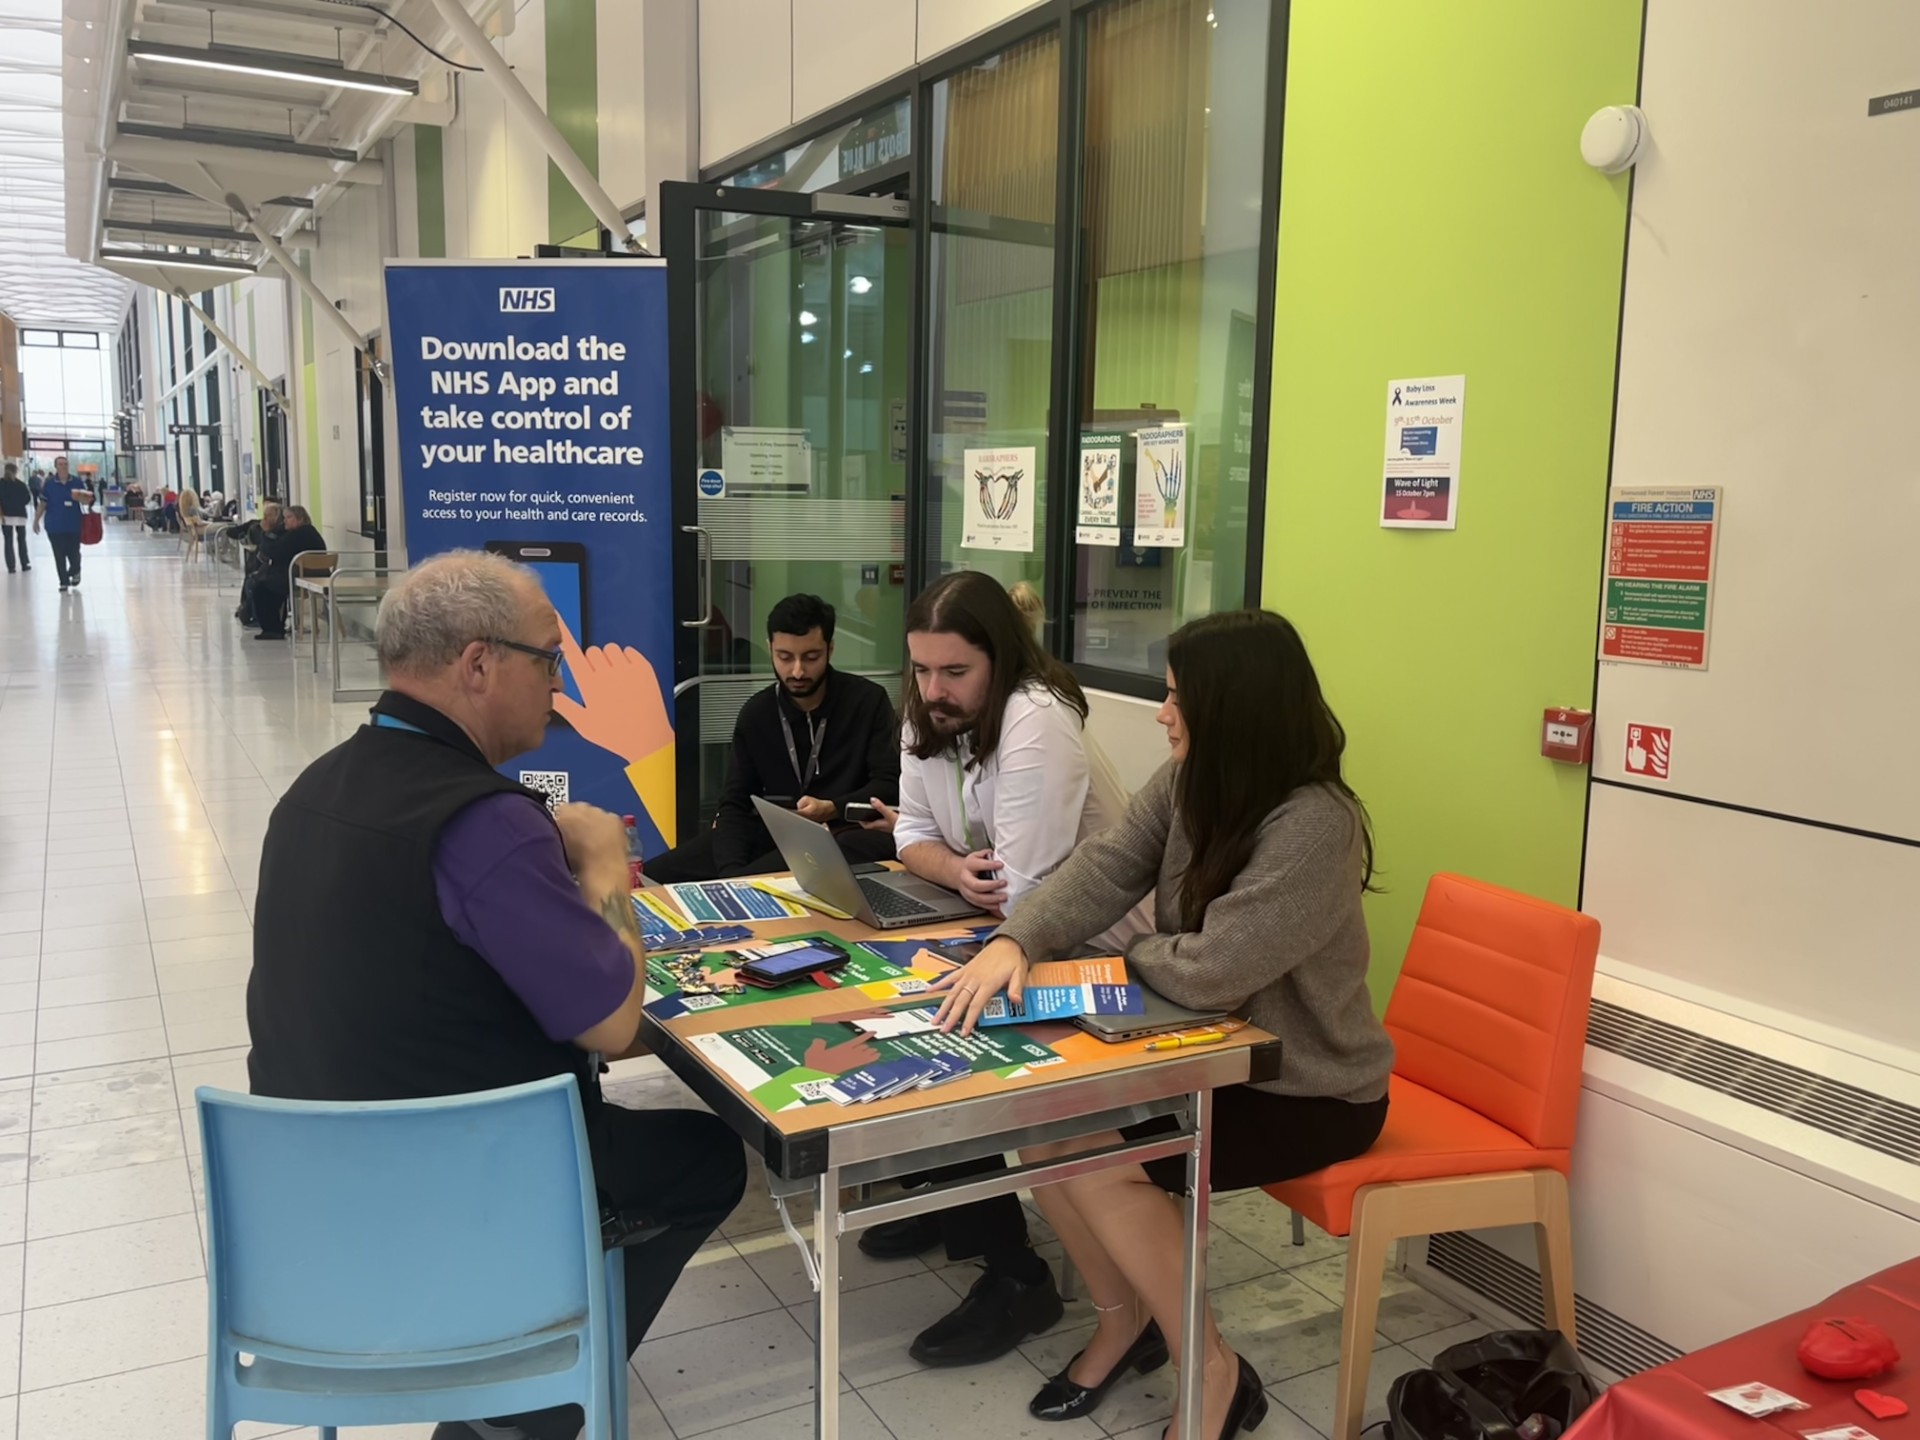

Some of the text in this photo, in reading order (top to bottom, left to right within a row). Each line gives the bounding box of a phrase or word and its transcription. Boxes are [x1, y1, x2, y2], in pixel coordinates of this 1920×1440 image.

[501, 289, 552, 311] NHS
[420, 335, 627, 361] Download the
[431, 370, 619, 401] NHS App and
[1406, 385, 1422, 393] Baby
[1439, 396, 1457, 405] Week
[420, 404, 632, 430] take control of
[1421, 415, 1454, 425] October
[420, 438, 645, 469] your healthcare
[1394, 478, 1439, 489] Wave of Light
[428, 489, 635, 505] Register now for quick, convenient
[1693, 489, 1714, 500] NHS
[1631, 503, 1694, 513] FIRE ACTION
[422, 508, 648, 522] access to your health and care records.
[1094, 589, 1162, 600] PREVENT THE
[1107, 601, 1162, 611] INFECTION
[1068, 988, 1077, 1004] Step
